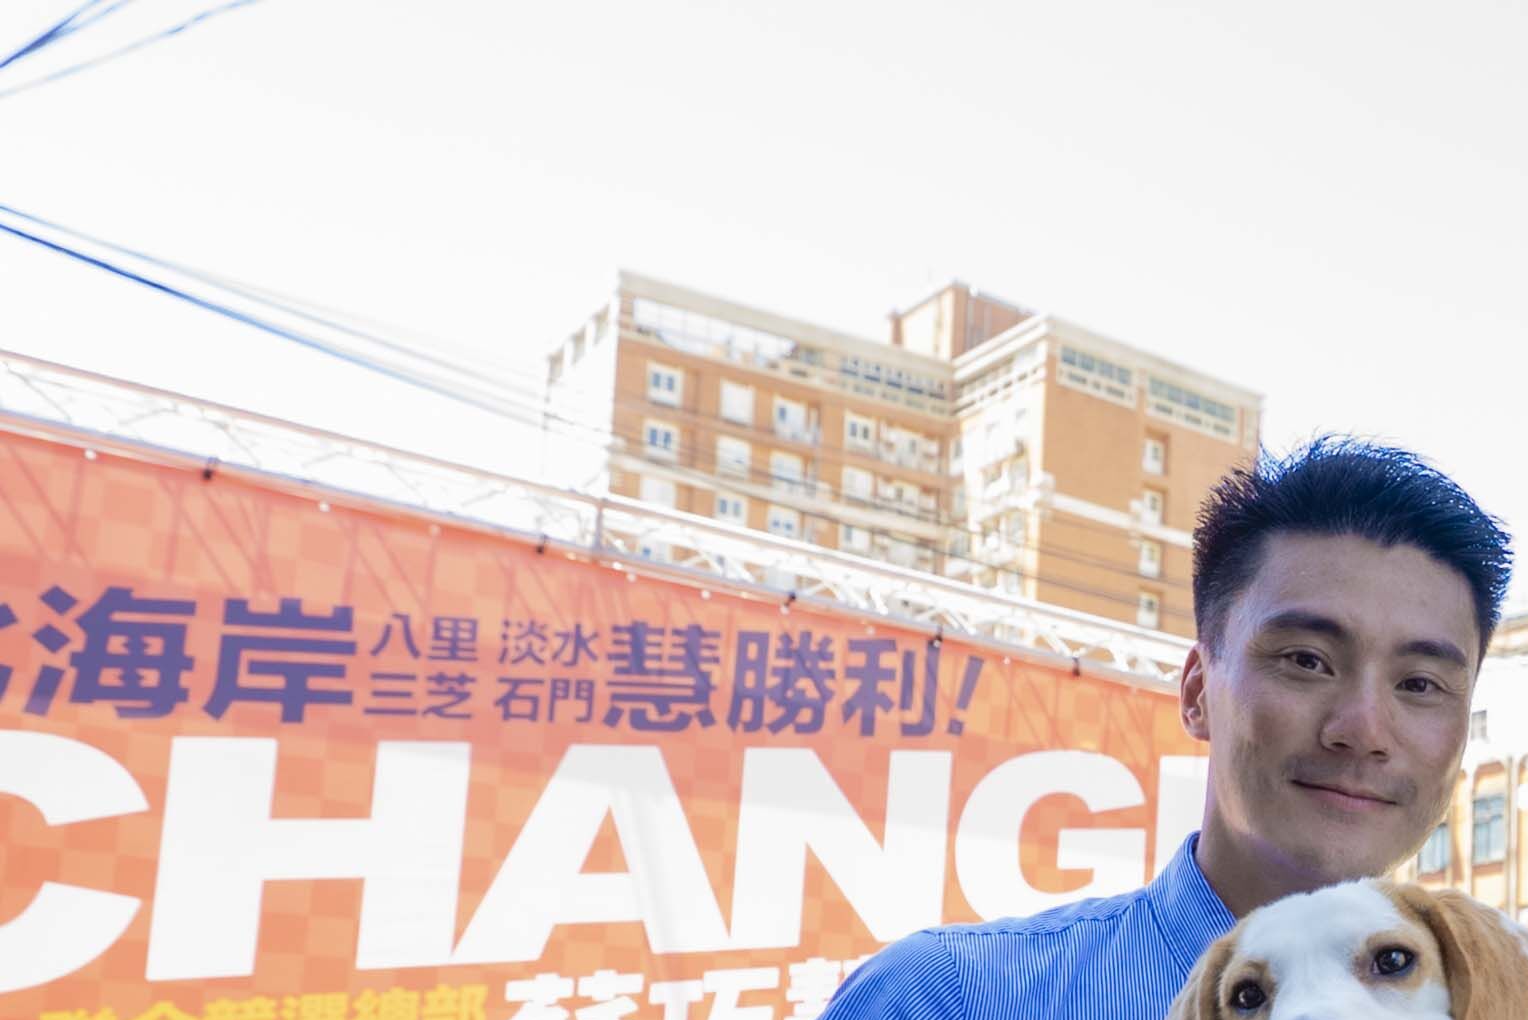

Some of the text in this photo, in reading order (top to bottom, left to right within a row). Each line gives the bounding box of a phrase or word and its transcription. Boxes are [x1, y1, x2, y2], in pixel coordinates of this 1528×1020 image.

[0, 585, 357, 723] 海岸
[363, 671, 595, 724] 三芝 石門
[369, 613, 599, 668] 八里 淡水
[602, 620, 985, 737] 慧勝利!
[0, 728, 1209, 995] CHANG
